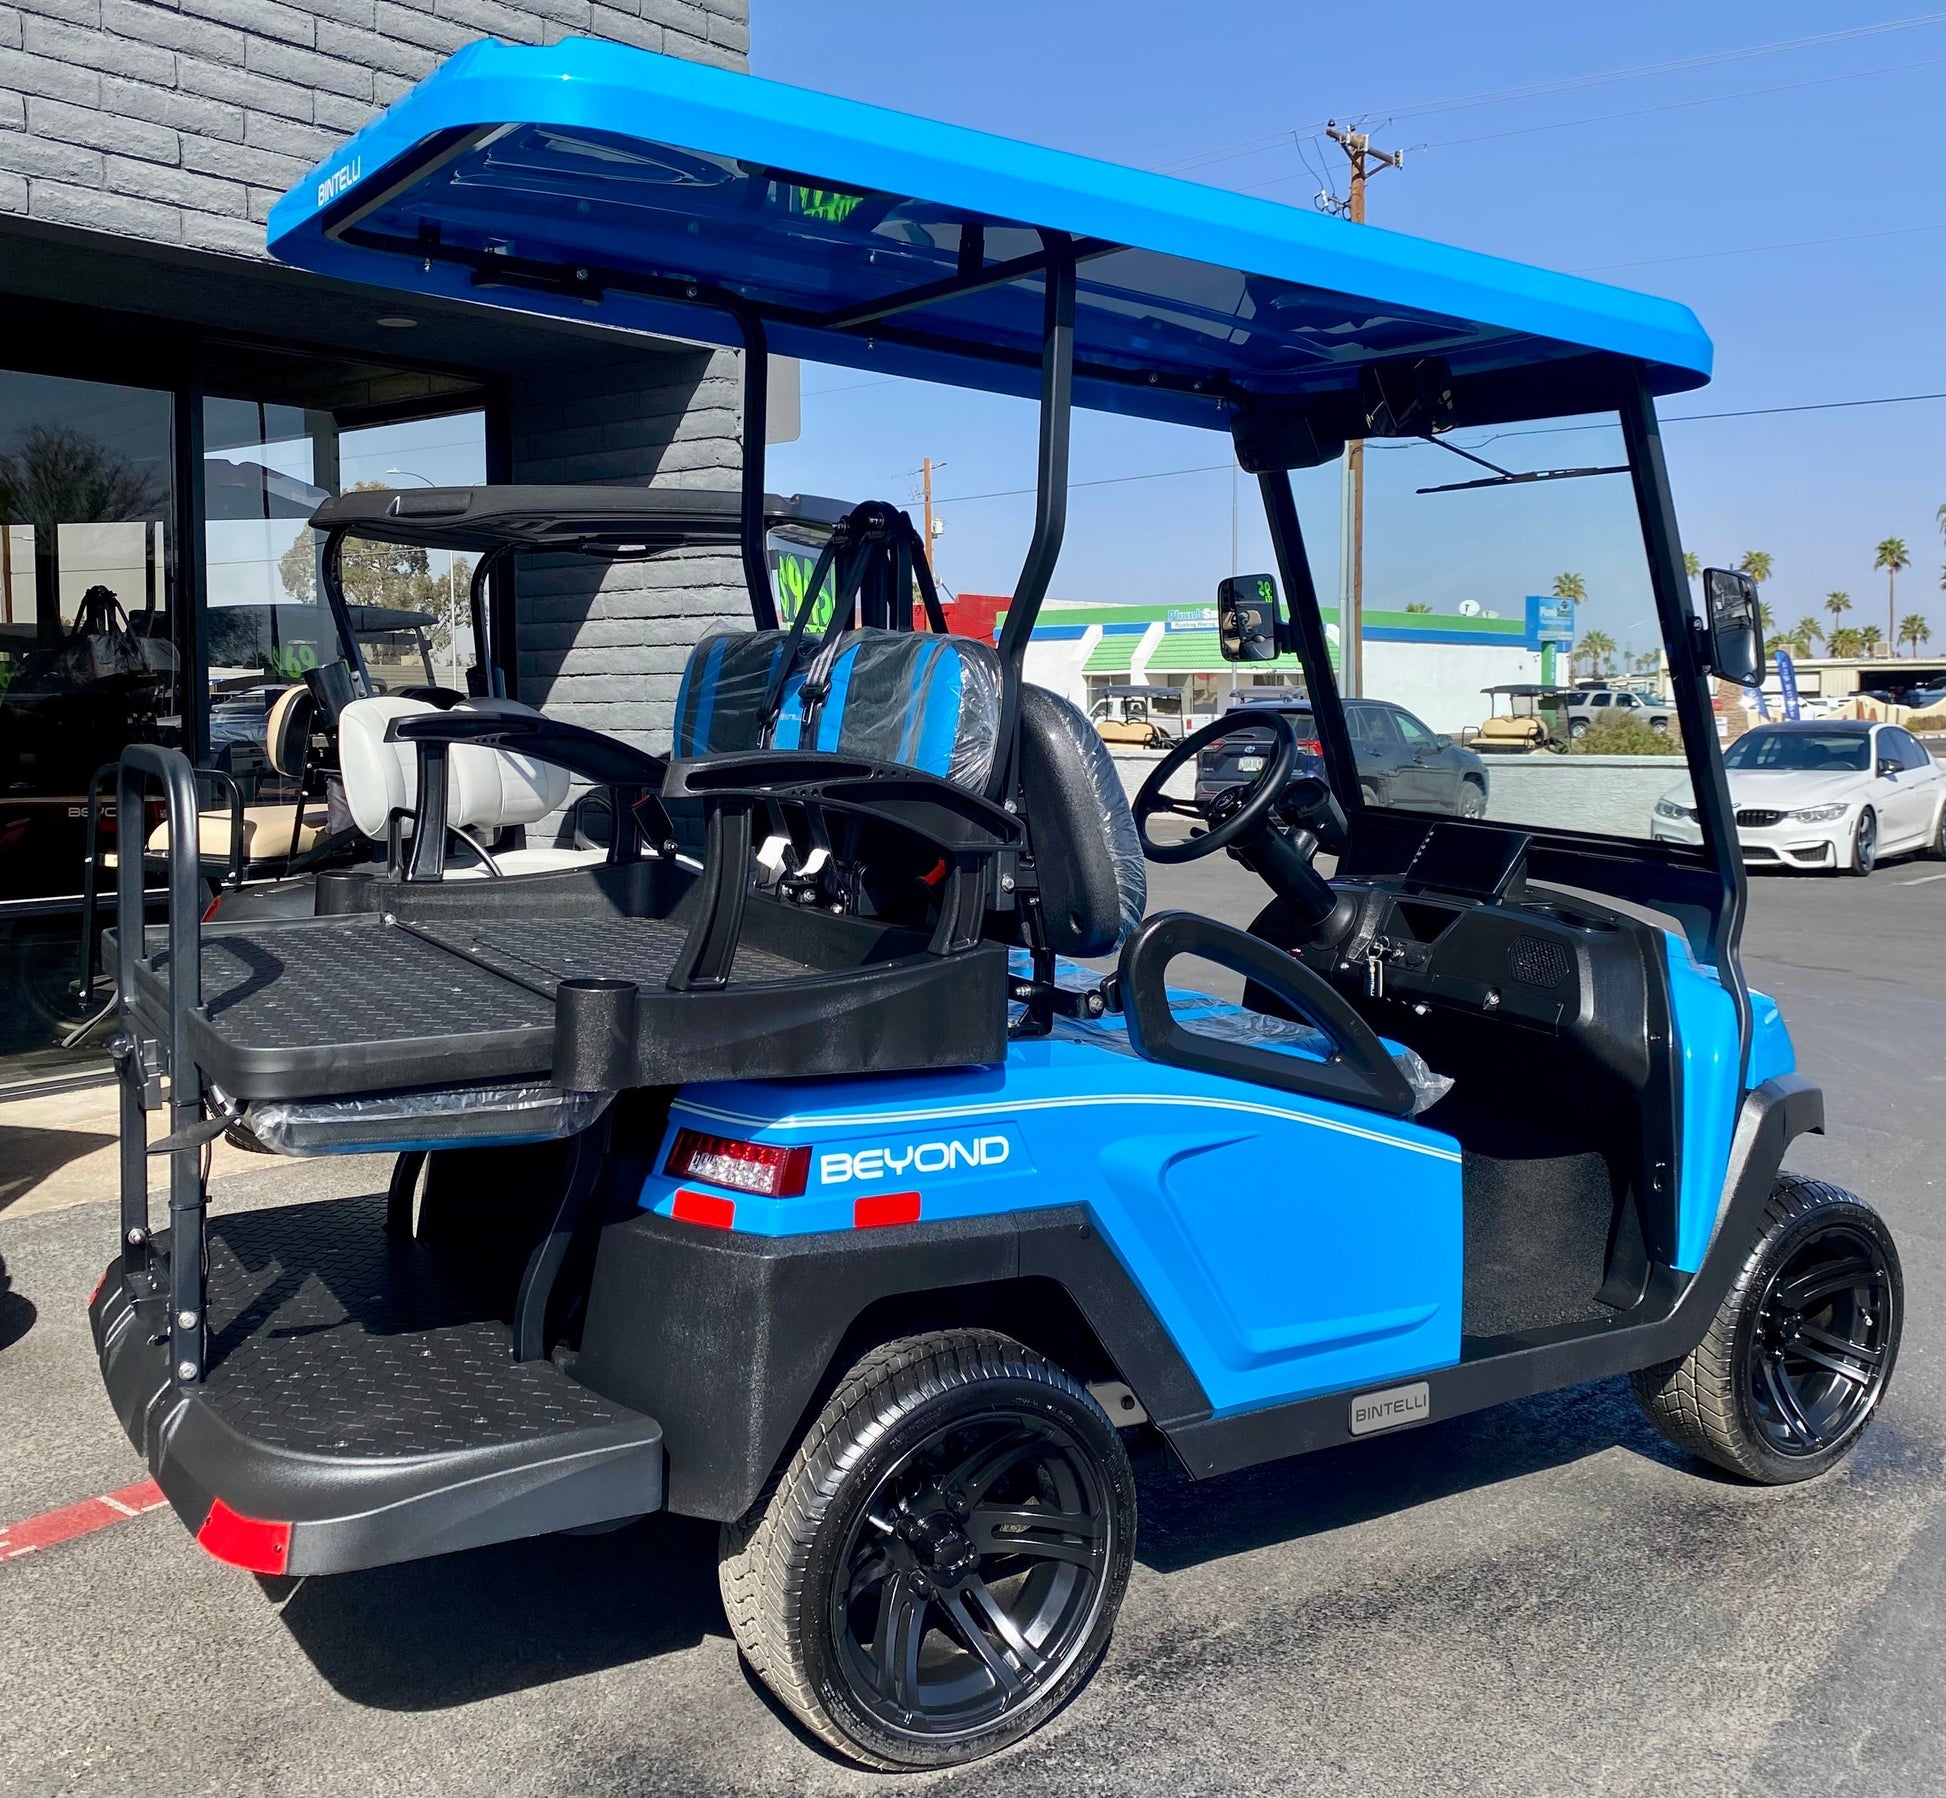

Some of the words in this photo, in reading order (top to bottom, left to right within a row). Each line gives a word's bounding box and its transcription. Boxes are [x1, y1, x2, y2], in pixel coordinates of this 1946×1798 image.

[318, 156, 360, 207] BINTELLI
[820, 1135, 1010, 1184] BEYOND
[1356, 1394, 1427, 1423] BINTELLI
